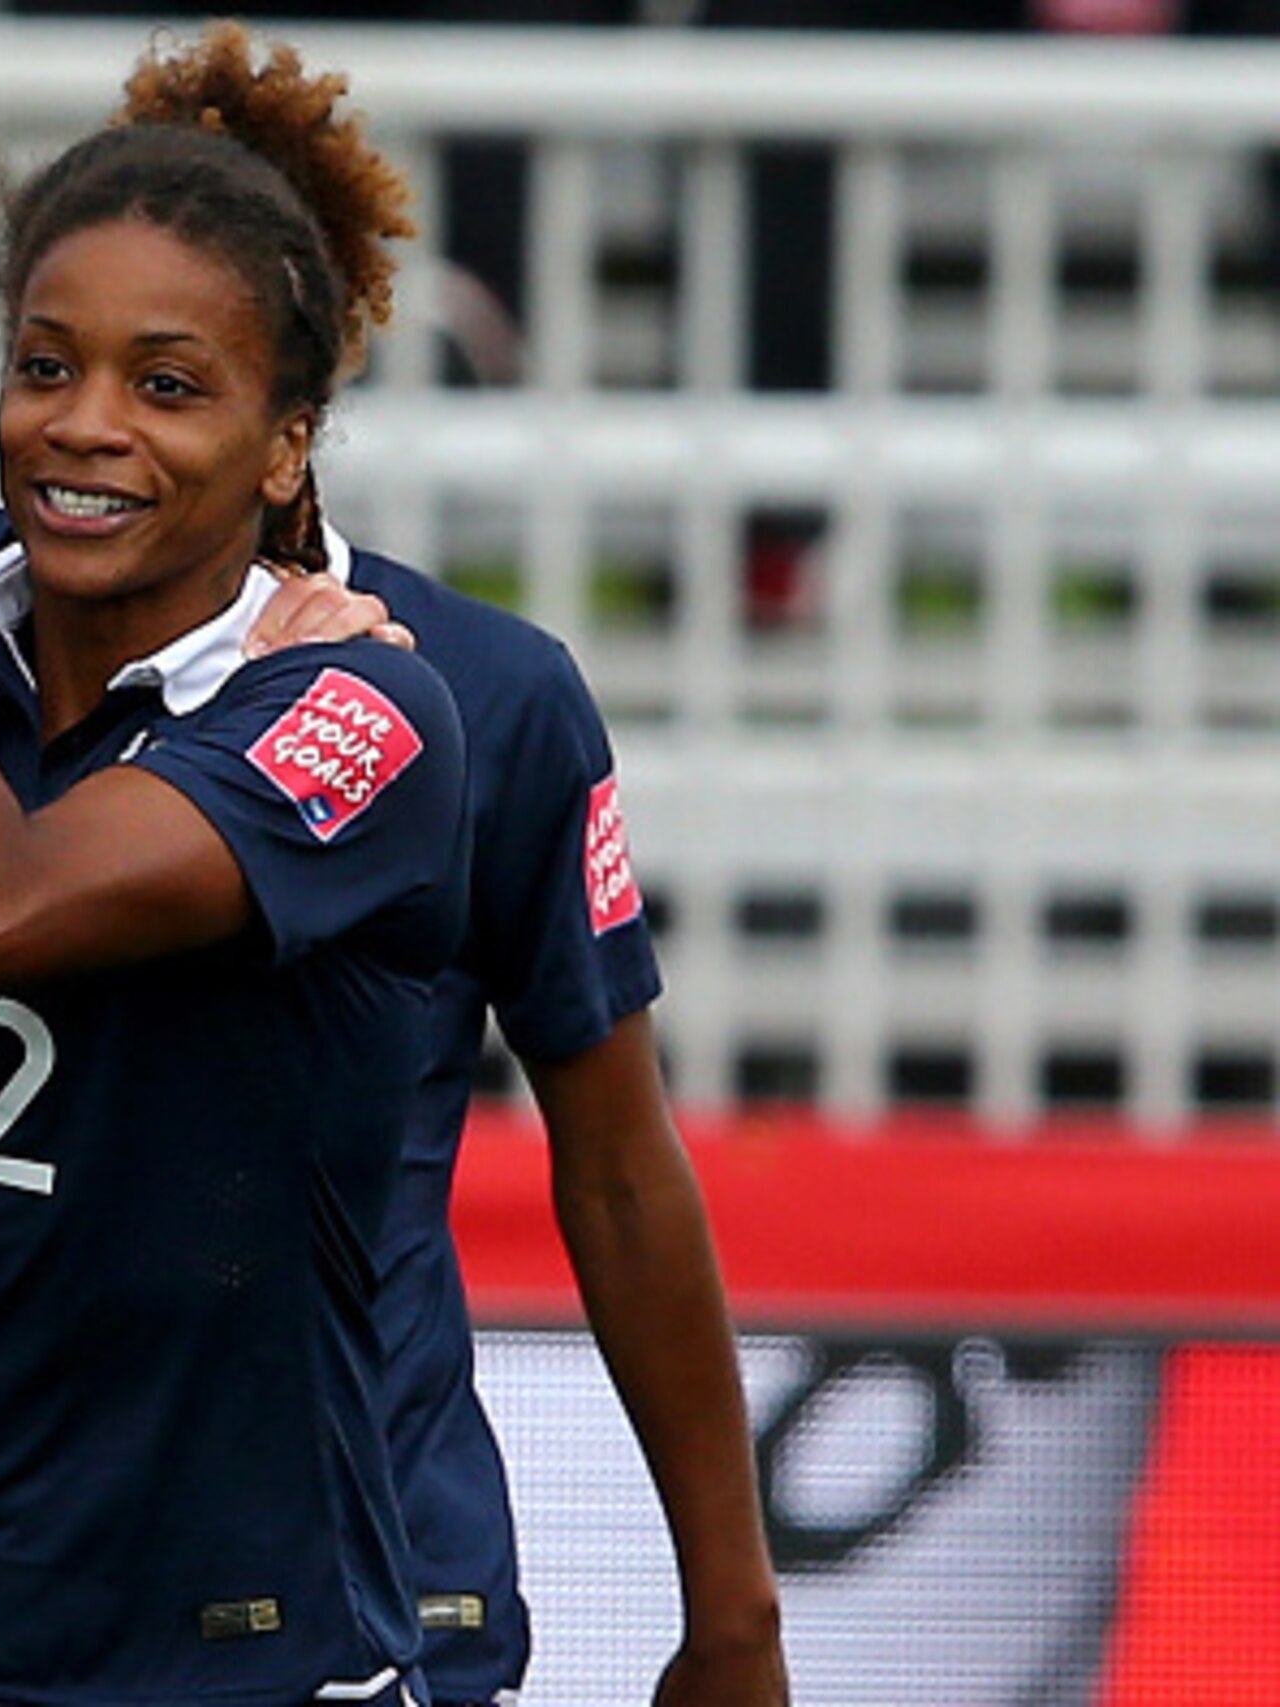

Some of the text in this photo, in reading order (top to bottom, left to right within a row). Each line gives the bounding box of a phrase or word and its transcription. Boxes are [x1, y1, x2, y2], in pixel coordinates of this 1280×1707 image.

[297, 710, 383, 779] YOUR
[316, 690, 393, 742] LIVE
[274, 734, 371, 803] GOALS
